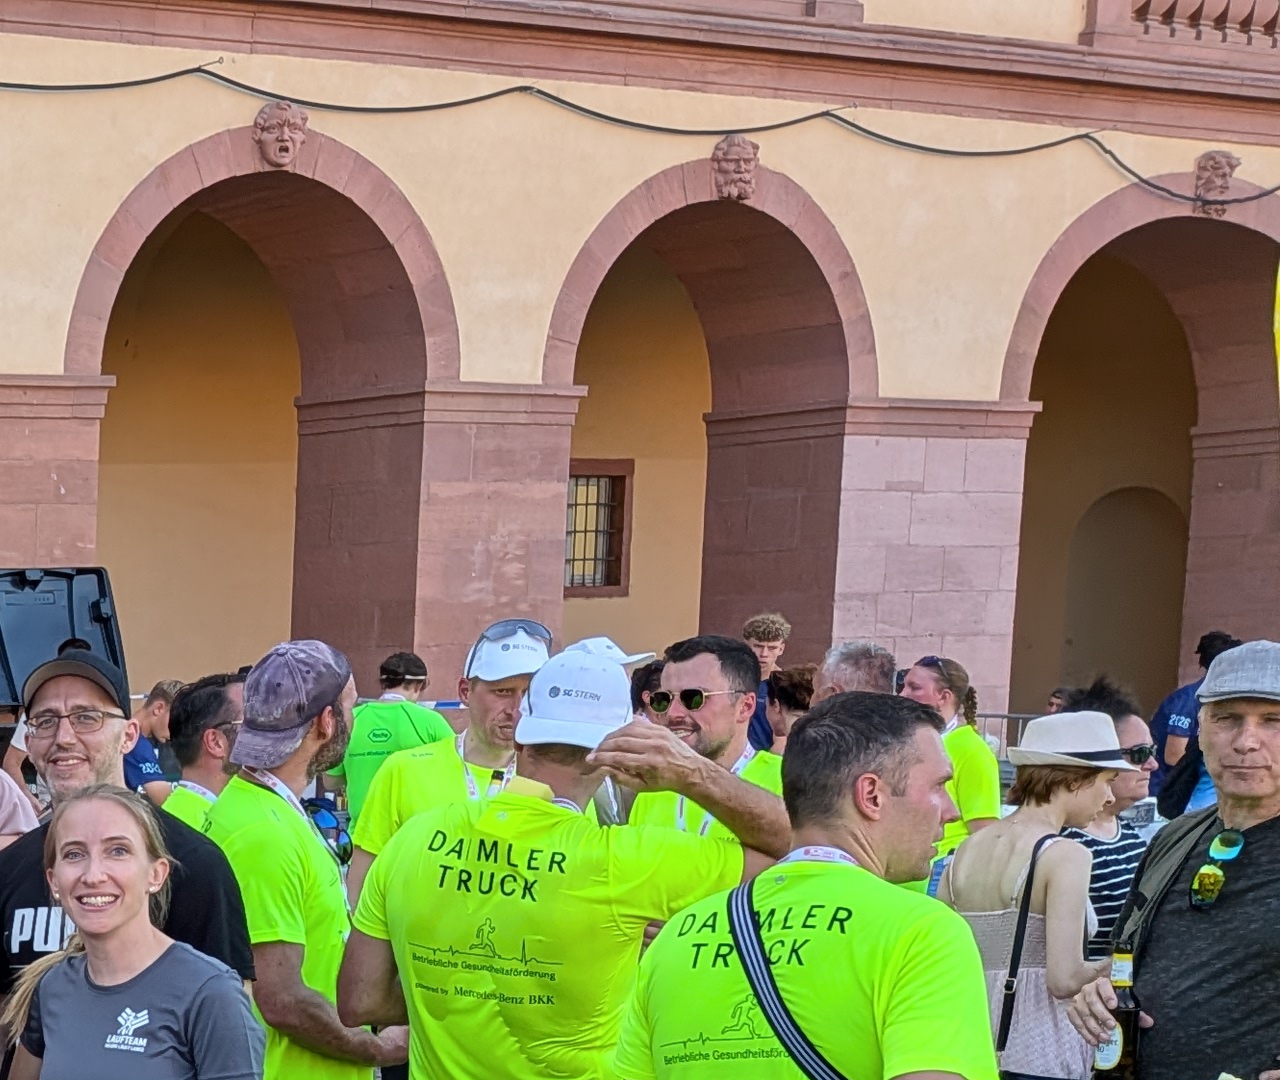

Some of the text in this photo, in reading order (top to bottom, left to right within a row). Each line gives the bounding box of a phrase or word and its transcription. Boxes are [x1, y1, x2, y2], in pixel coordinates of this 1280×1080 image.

[562, 688, 601, 701] SG STERN
[427, 830, 567, 874] DAIMLER
[438, 864, 538, 902] TRUCK
[677, 905, 853, 938] DAMLER
[412, 952, 556, 981] Betriebliche Gesundheitsförderung
[691, 939, 811, 969] TRCK
[453, 986, 525, 1005] Mercedes-Benz
[528, 994, 555, 1005] BKK
